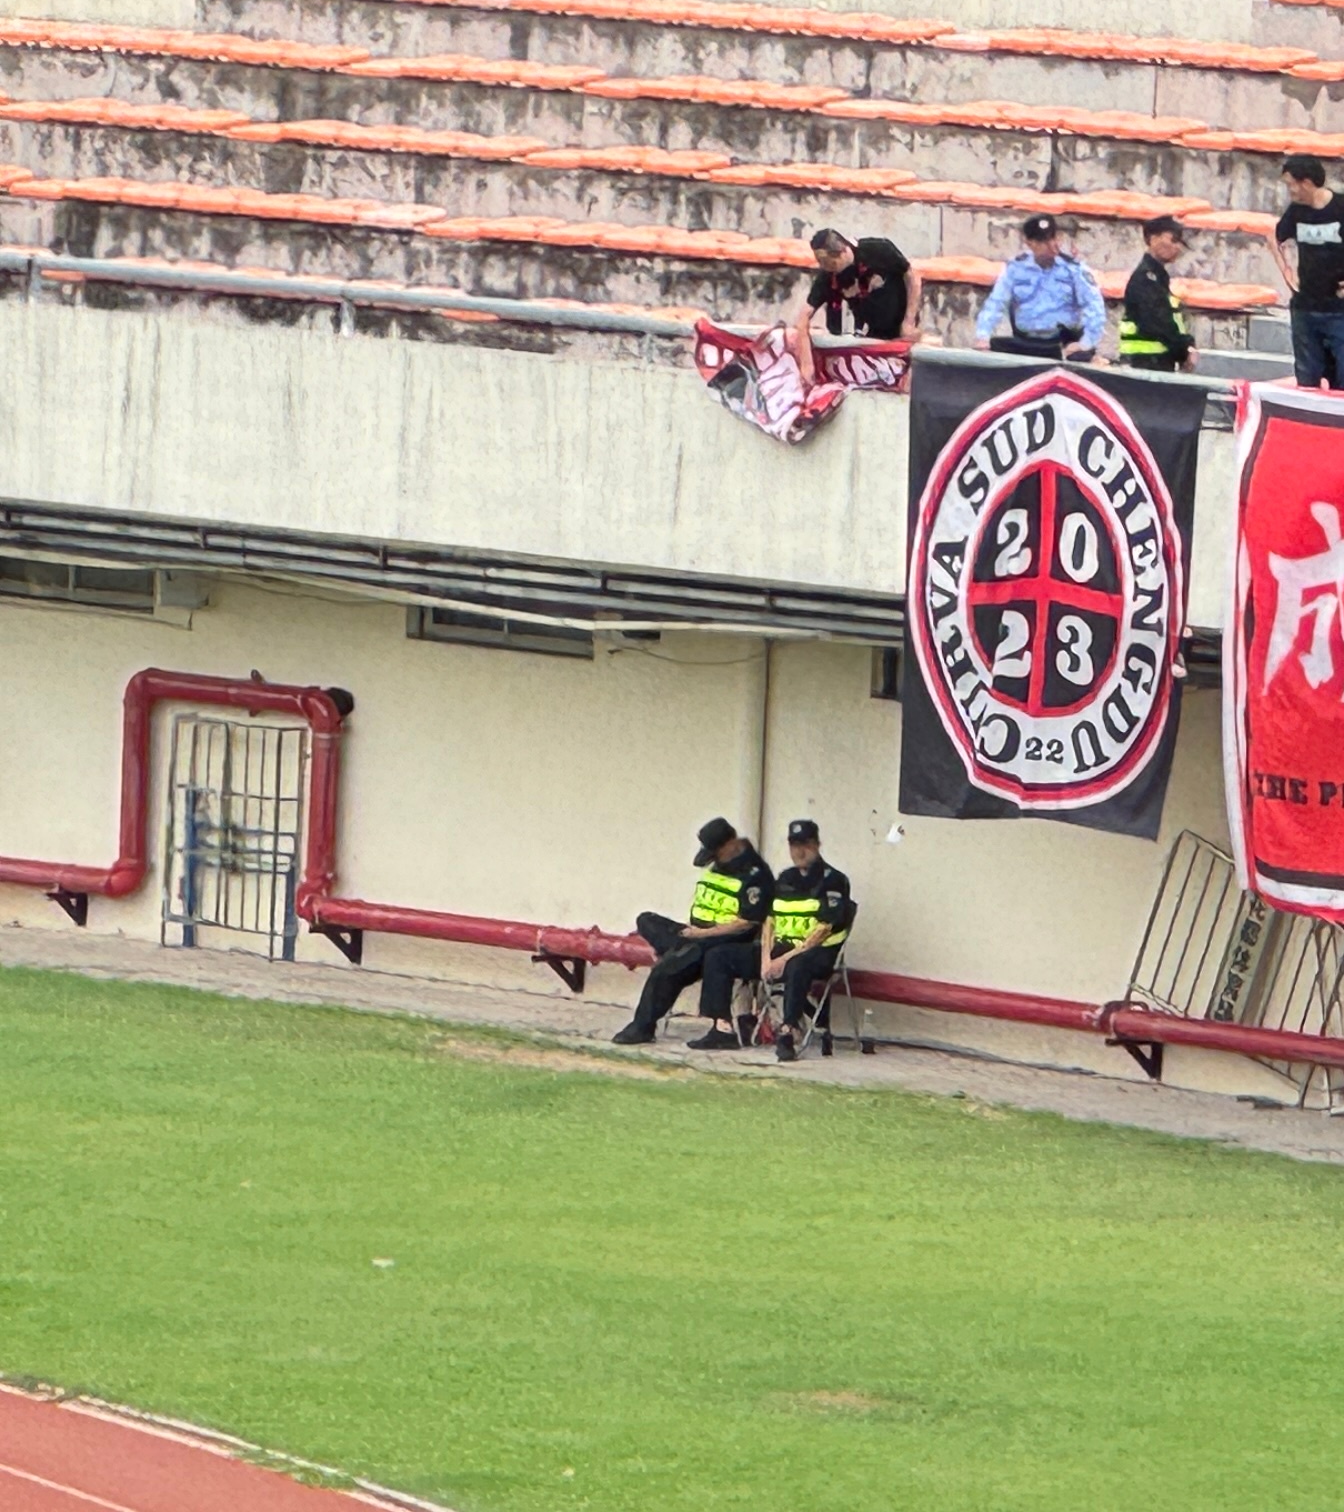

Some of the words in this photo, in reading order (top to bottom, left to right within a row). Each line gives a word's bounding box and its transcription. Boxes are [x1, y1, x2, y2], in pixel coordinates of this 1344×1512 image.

[957, 402, 1056, 515] SUD
[930, 535, 1020, 763] CURVA
[1071, 424, 1164, 774] CHENGDU
[1024, 736, 1065, 764] 22
[1252, 768, 1309, 806] THE
